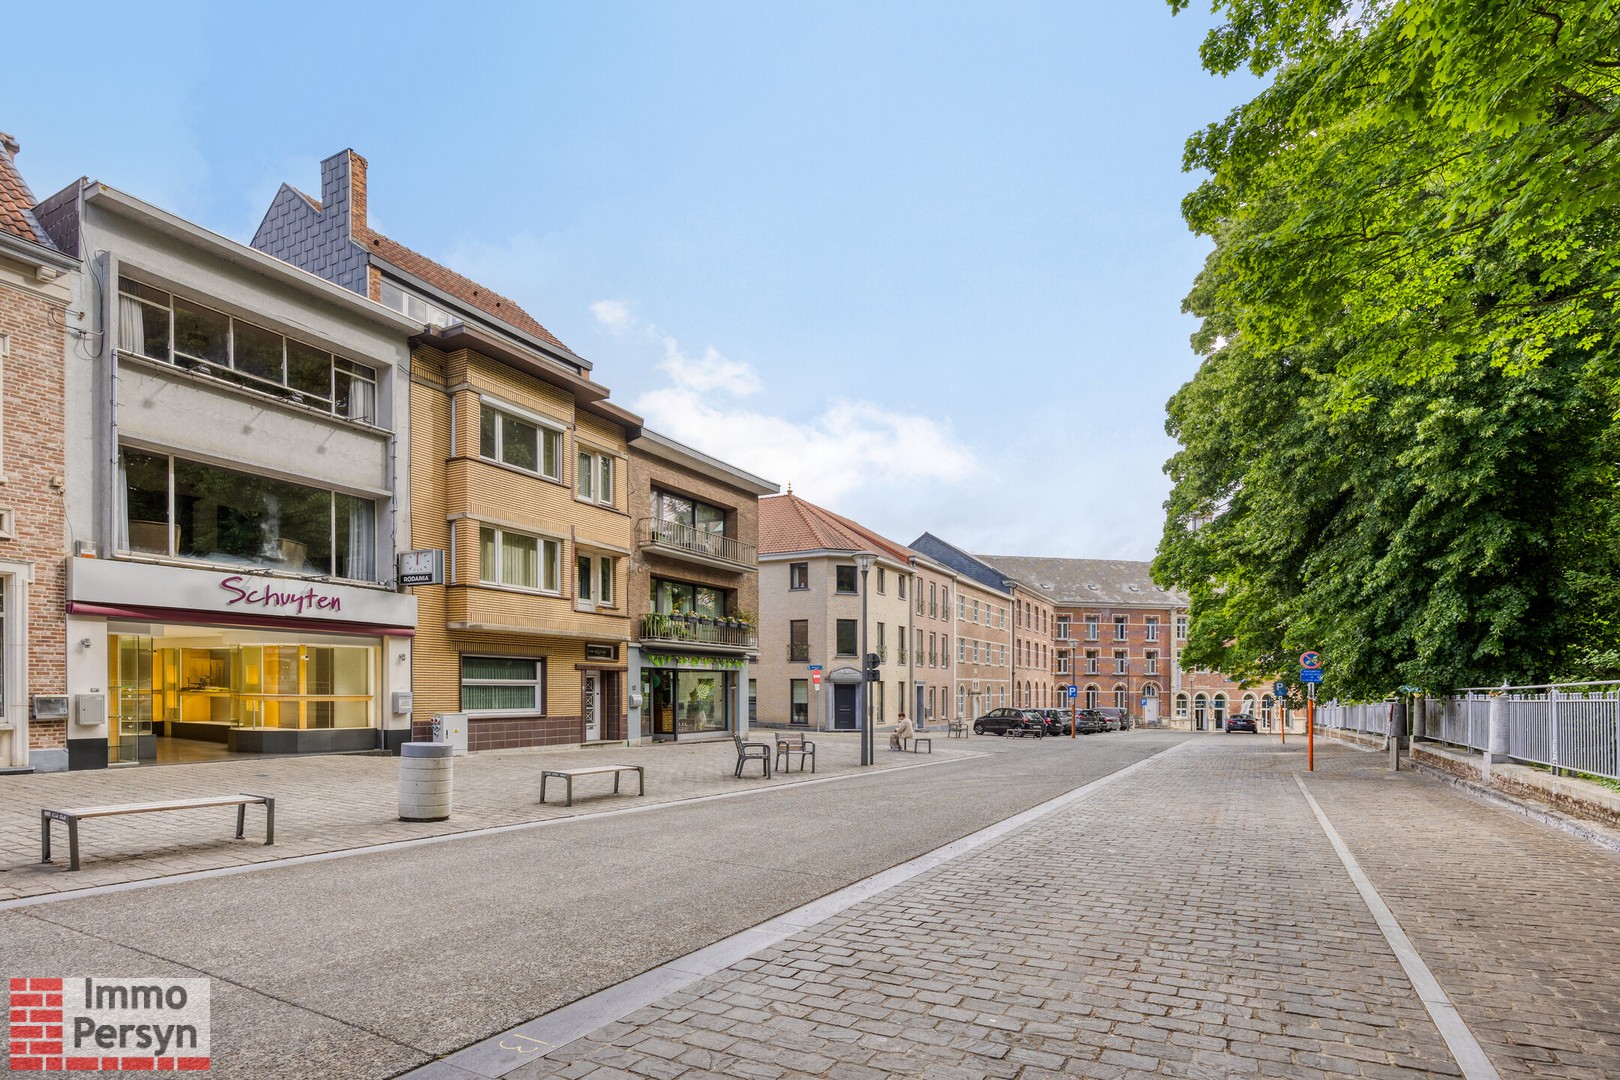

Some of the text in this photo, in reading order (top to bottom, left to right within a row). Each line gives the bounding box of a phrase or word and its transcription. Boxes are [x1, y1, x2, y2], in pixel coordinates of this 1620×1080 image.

[403, 575, 429, 583] RODANIA
[220, 576, 341, 614] Schuyten
[1276, 682, 1284, 691] P
[1068, 687, 1076, 696] P
